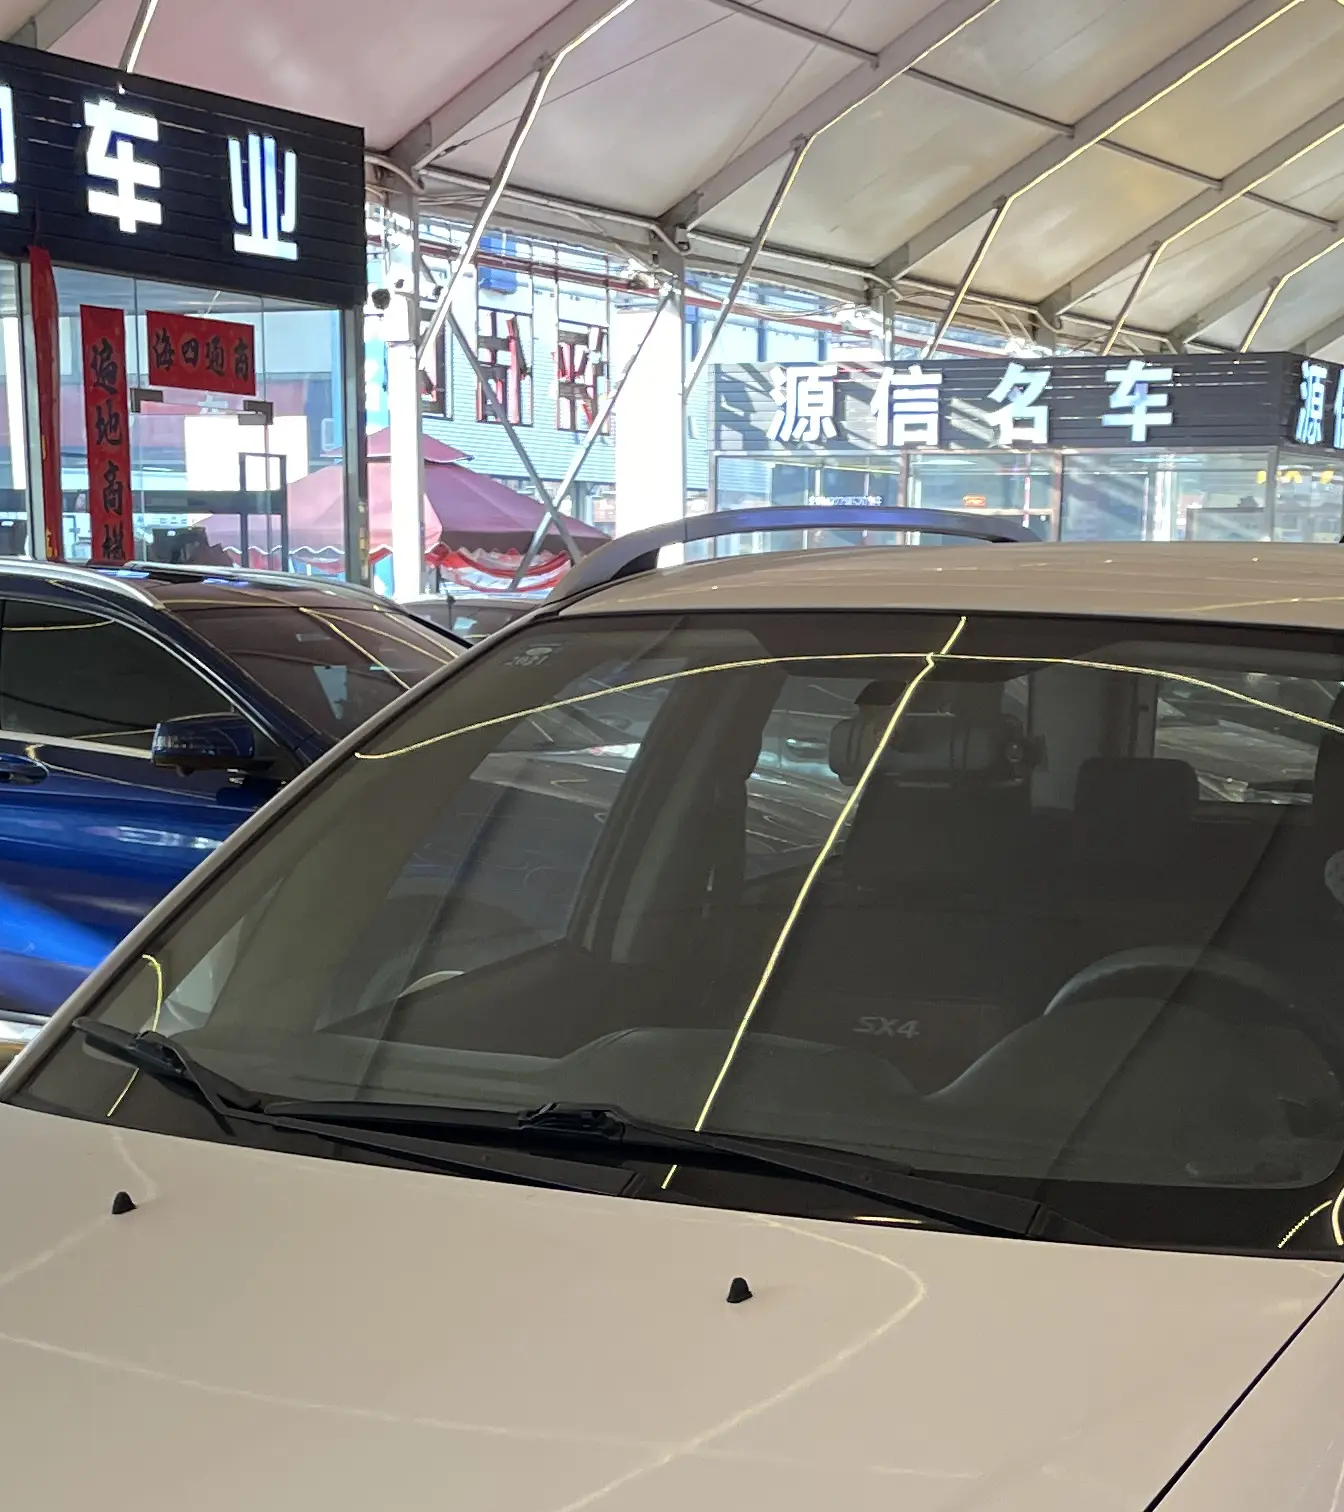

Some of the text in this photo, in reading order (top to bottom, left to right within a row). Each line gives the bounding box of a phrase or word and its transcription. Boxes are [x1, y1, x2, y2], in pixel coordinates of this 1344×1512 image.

[765, 359, 1174, 447] 源信名车
[851, 1016, 921, 1039] SX4
